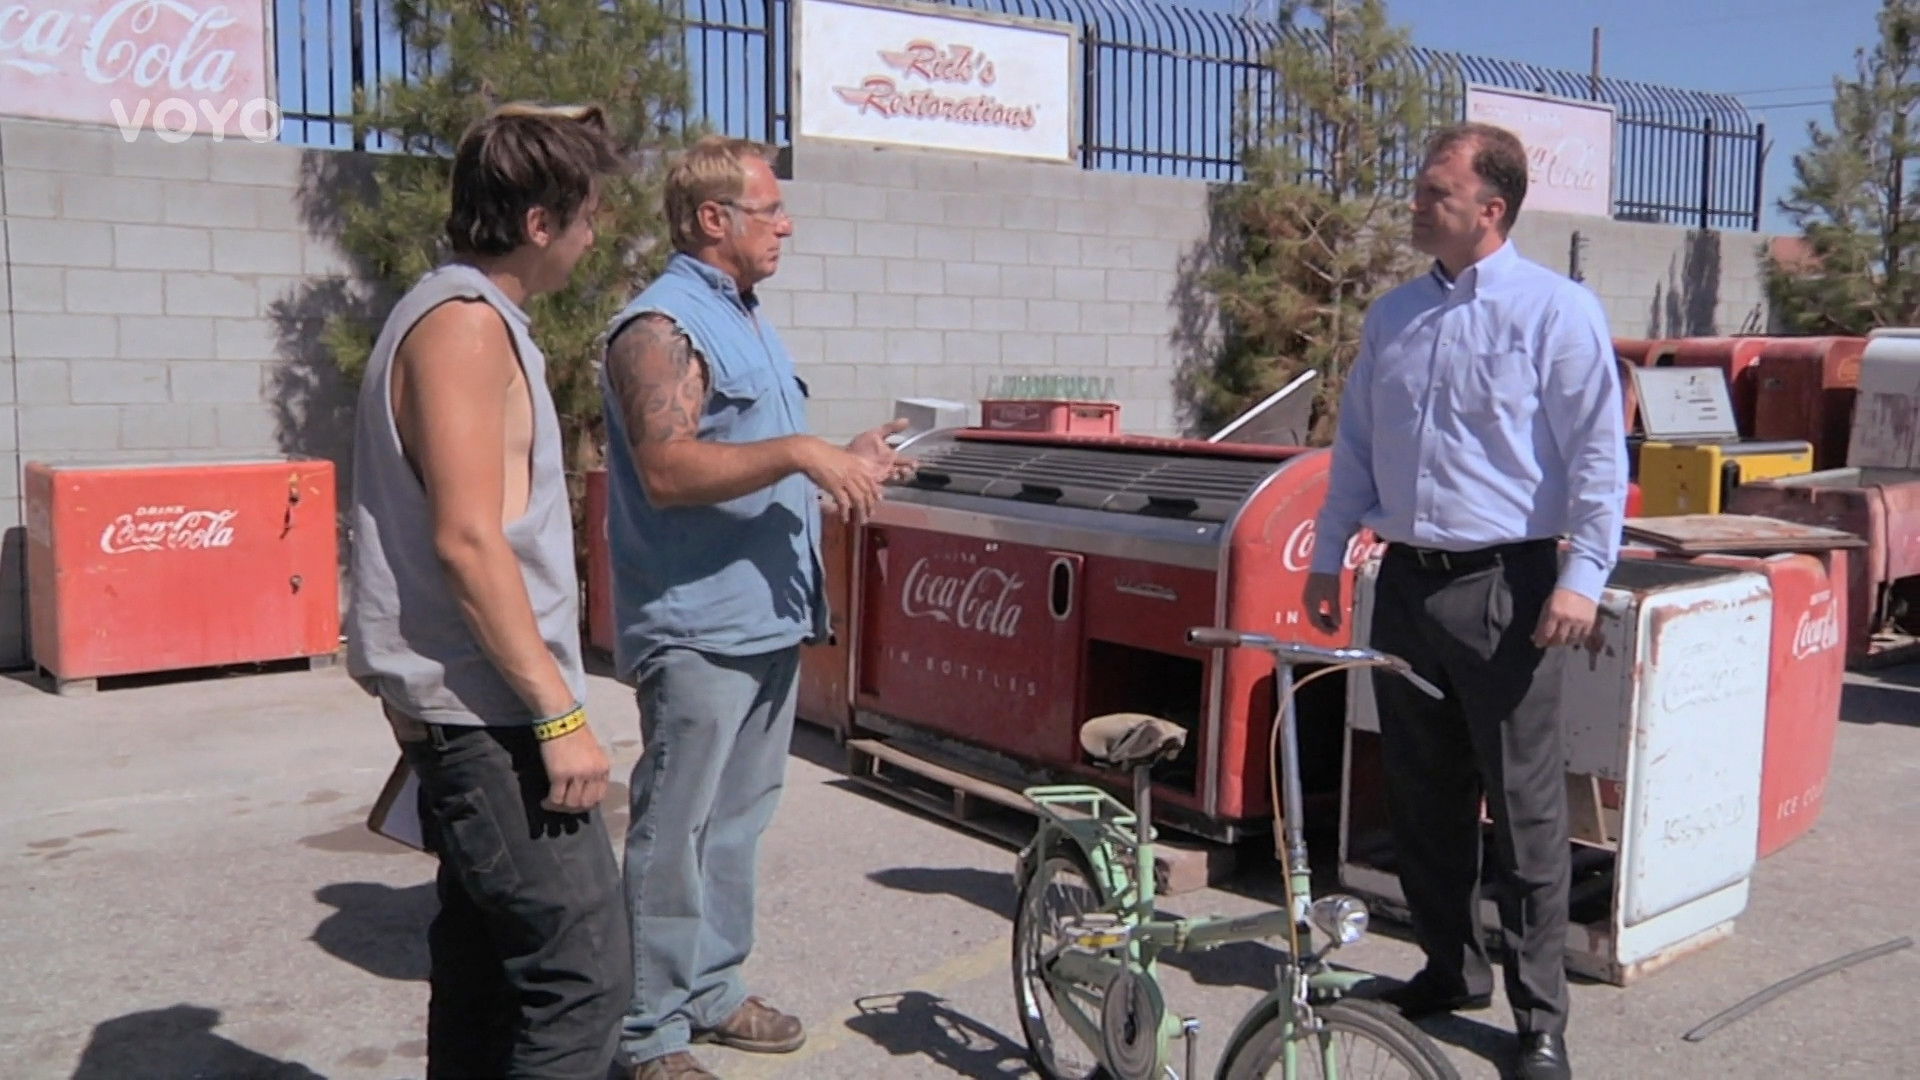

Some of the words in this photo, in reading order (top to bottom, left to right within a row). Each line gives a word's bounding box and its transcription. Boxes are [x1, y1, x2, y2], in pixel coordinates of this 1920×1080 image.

[0, 0, 237, 91] ca-Cola
[877, 38, 996, 87] Rick's
[832, 74, 1037, 130] Restorations
